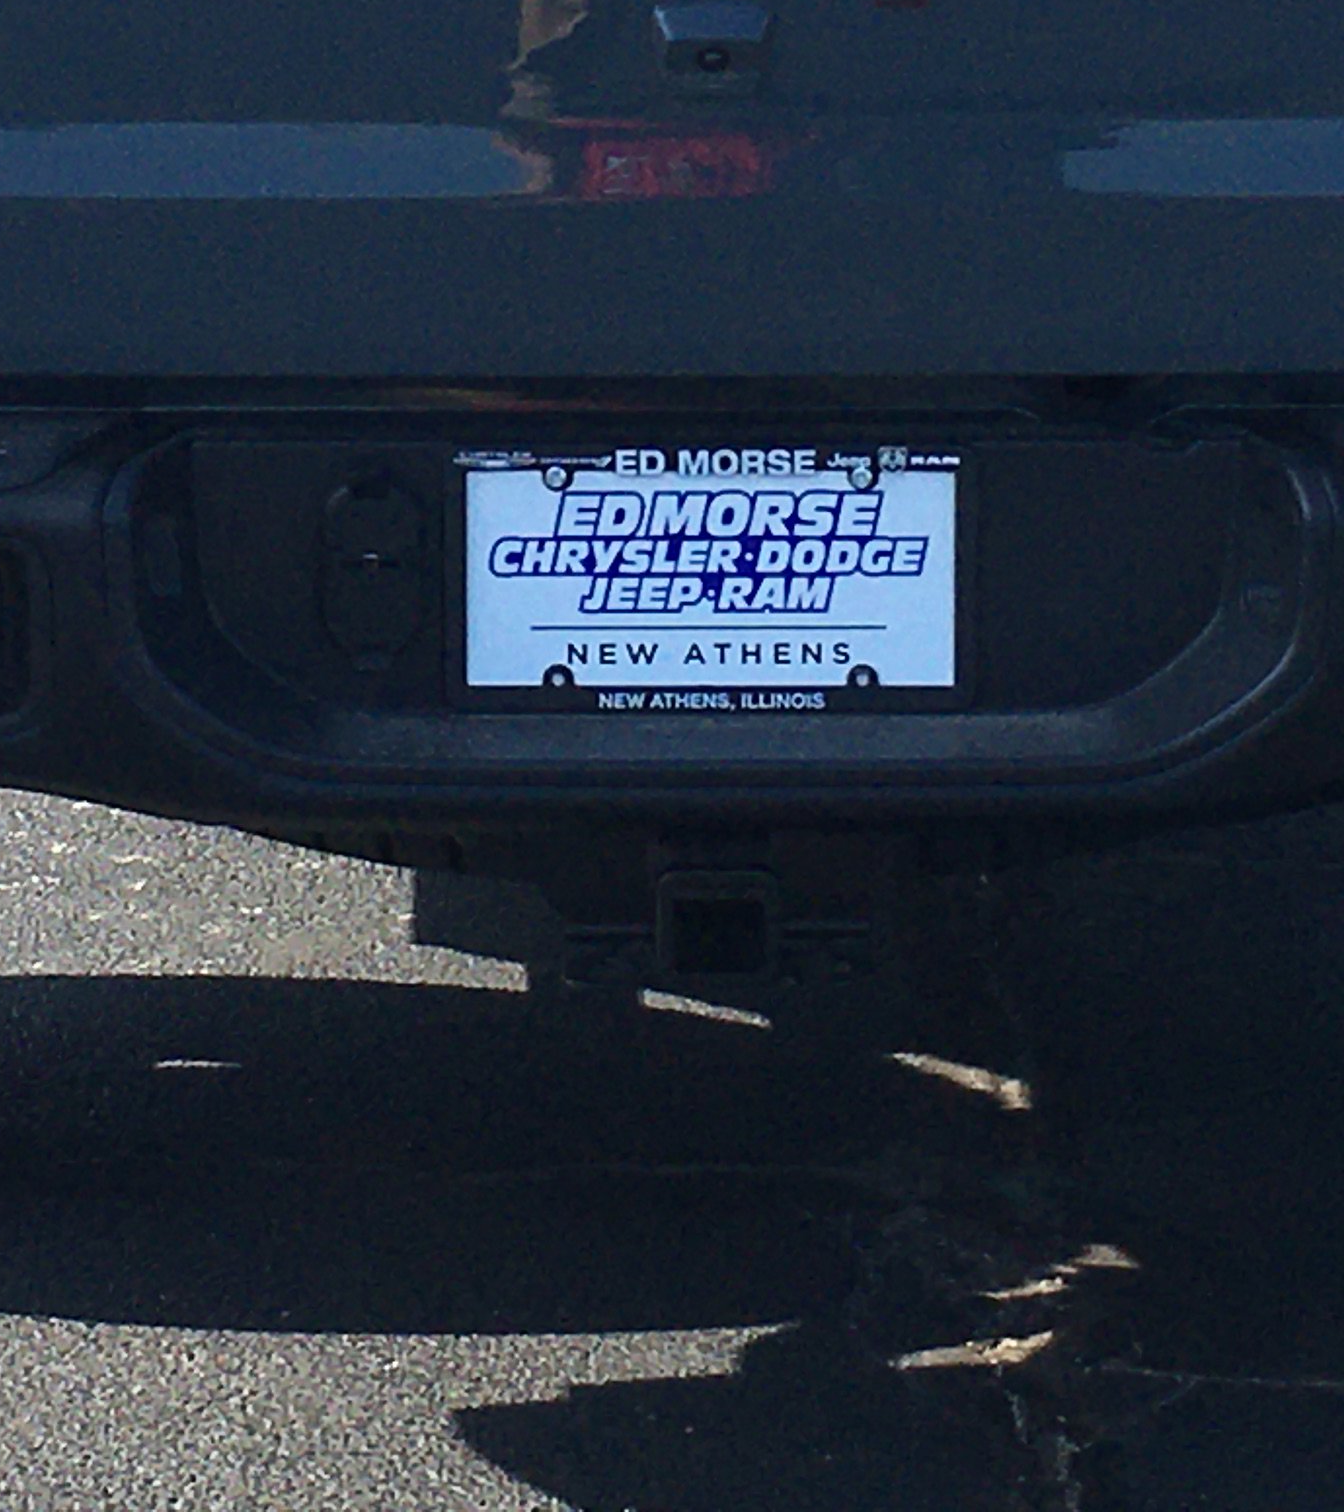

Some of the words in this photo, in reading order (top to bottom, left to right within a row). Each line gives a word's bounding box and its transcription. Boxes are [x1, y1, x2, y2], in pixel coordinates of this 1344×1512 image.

[615, 449, 666, 477] ED
[678, 449, 816, 477] MORSE
[558, 491, 644, 537] ED
[653, 491, 884, 537] MORSE
[567, 642, 659, 665] NEW
[683, 642, 852, 665] ATHENS
[598, 692, 648, 710] NEW
[650, 692, 737, 713] ATHENS,
[740, 692, 826, 710] ILLINOIS
